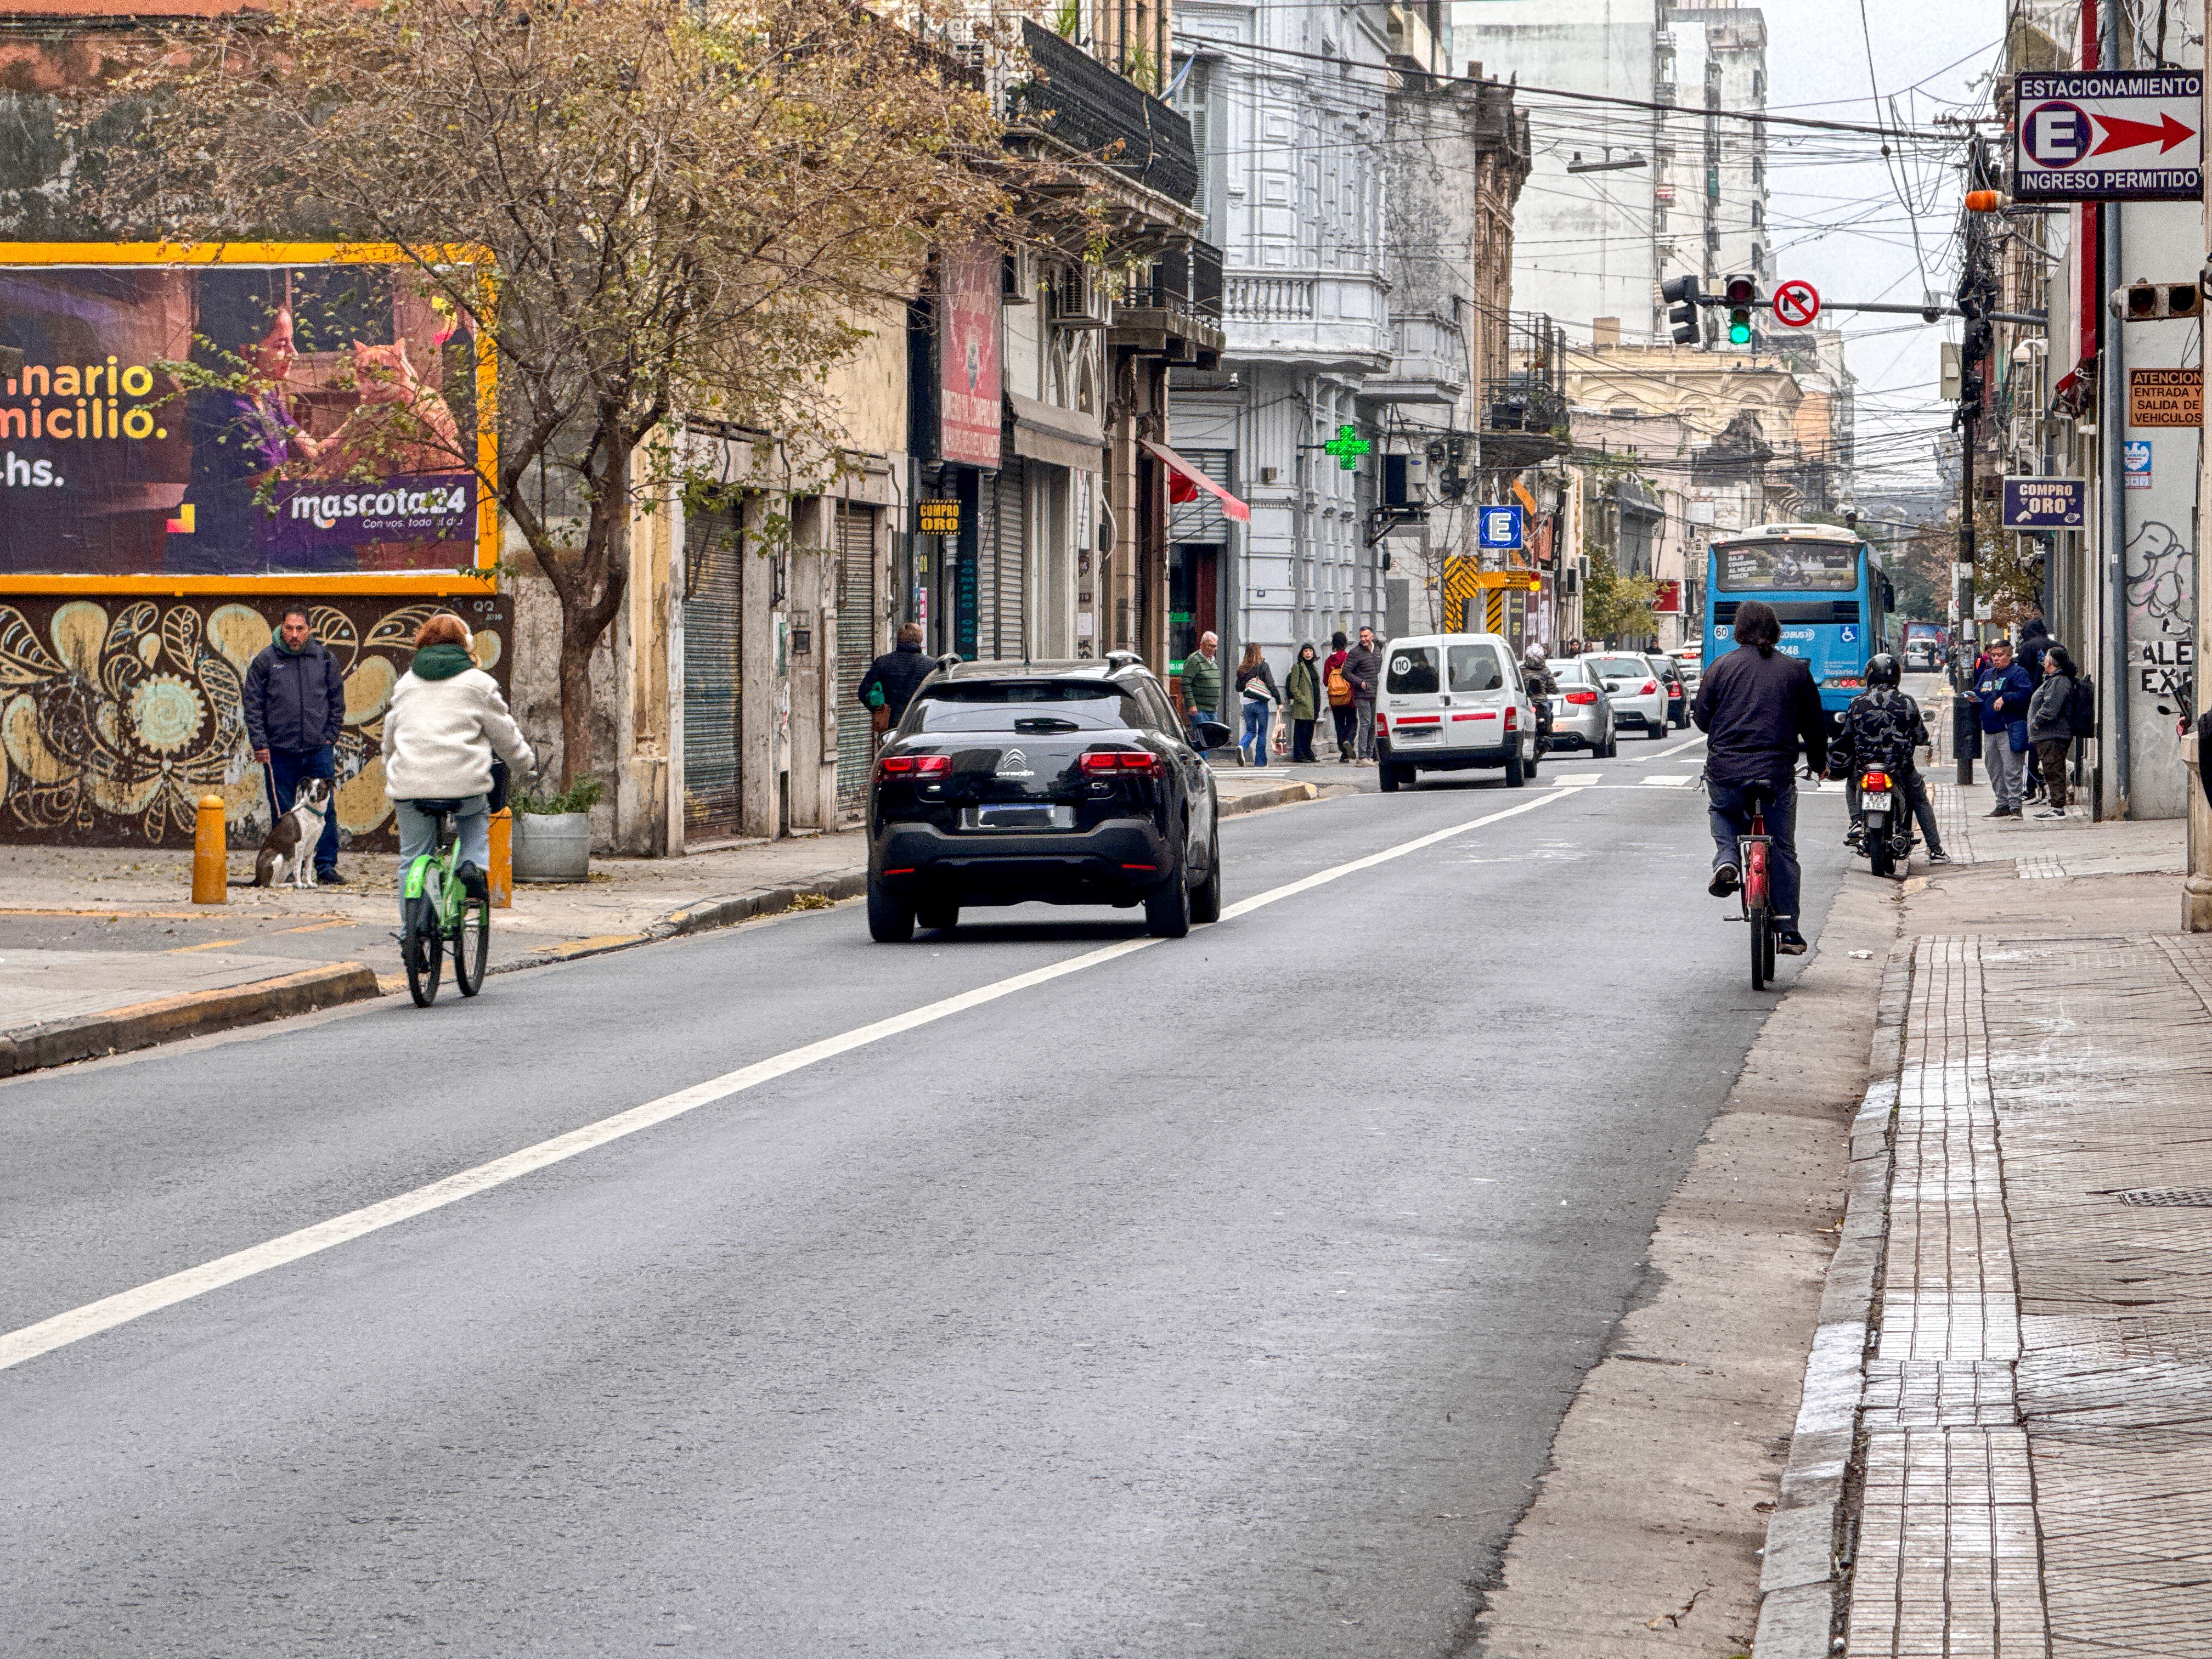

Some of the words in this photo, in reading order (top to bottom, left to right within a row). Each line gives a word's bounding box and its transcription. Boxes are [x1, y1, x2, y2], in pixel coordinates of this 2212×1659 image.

[2021, 77, 2200, 98] ESTACIONAMIENTO
[2035, 111, 2078, 159] E
[2021, 173, 2100, 190] INGRESO
[2103, 171, 2198, 189] PERMITIDO
[2134, 371, 2203, 385] ATENCION
[2134, 387, 2189, 397] ENTRADA
[2193, 386, 2202, 397] Y
[2137, 400, 2179, 410] SALIDA
[2183, 399, 2200, 410] DE
[2134, 412, 2203, 424] VEHICULOS
[0, 450, 65, 487] hs.
[2019, 483, 2073, 496] COMPRO
[291, 486, 467, 528] mascota24
[919, 504, 960, 517] COMPRO
[2029, 497, 2067, 514] ORO
[363, 518, 383, 528] Con
[409, 517, 432, 527] todo
[921, 518, 959, 531] ORO
[1488, 512, 1511, 541] E
[1716, 627, 1727, 637] 60
[1395, 659, 1409, 672] 110
